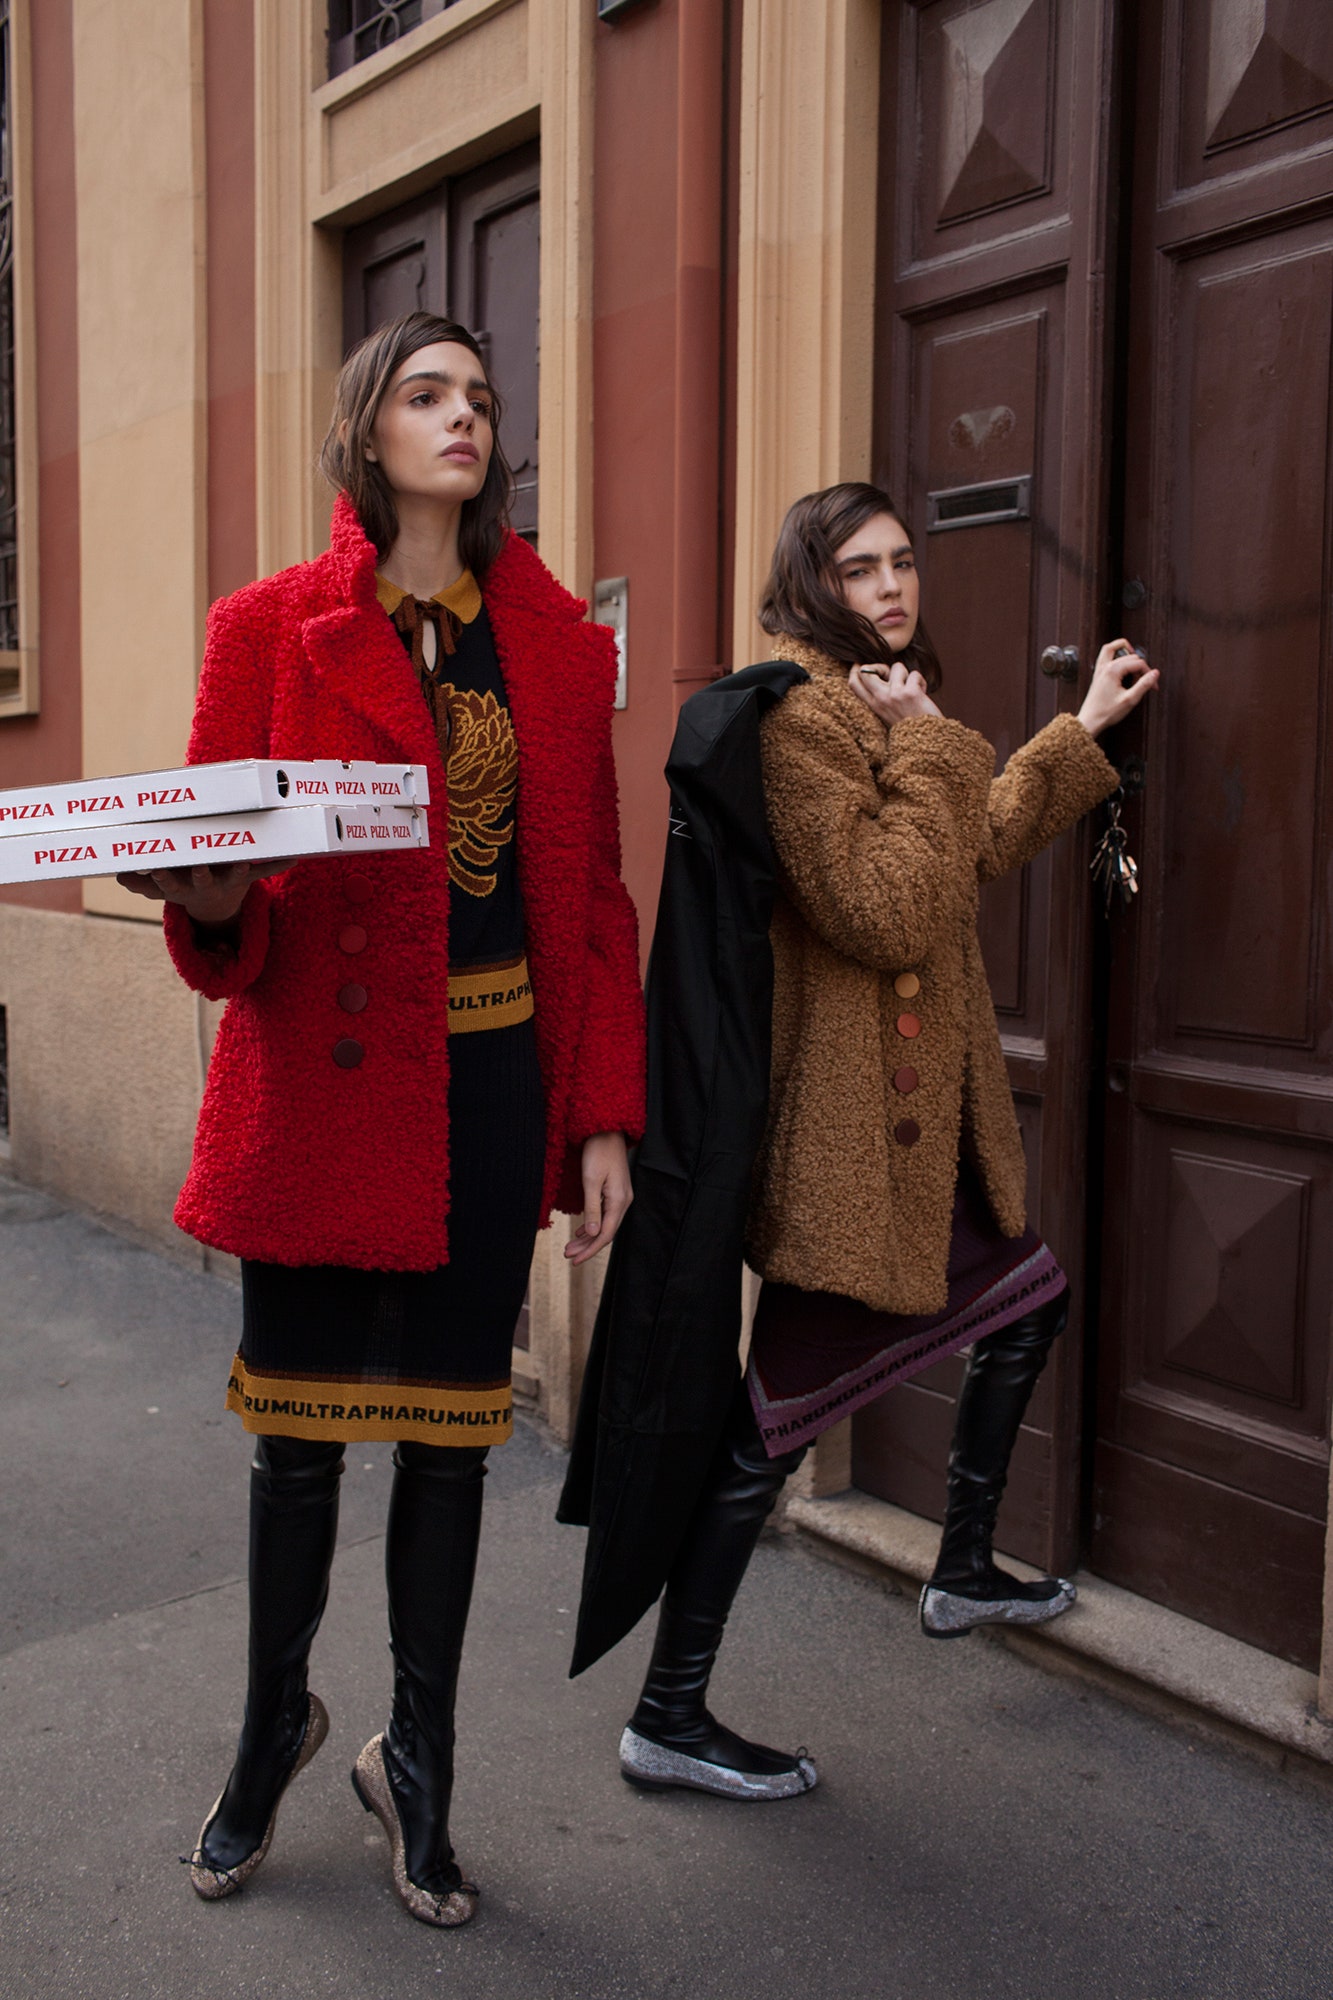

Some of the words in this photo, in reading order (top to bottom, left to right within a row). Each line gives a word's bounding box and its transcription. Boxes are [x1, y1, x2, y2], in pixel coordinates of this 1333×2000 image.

[296, 781, 329, 795] PIZZA
[336, 782, 366, 795] PIZZA
[372, 782, 401, 795] PIZZA
[0, 803, 54, 821] PIZZA
[67, 796, 124, 814] PIZZA
[138, 788, 196, 807] PIZZA
[347, 825, 367, 839] PIZZA
[371, 825, 390, 839] PIZZA
[393, 825, 411, 839] PIZZA
[35, 846, 97, 865] PIZZA
[112, 838, 176, 857] PIZZA
[191, 831, 256, 850] PIZZA
